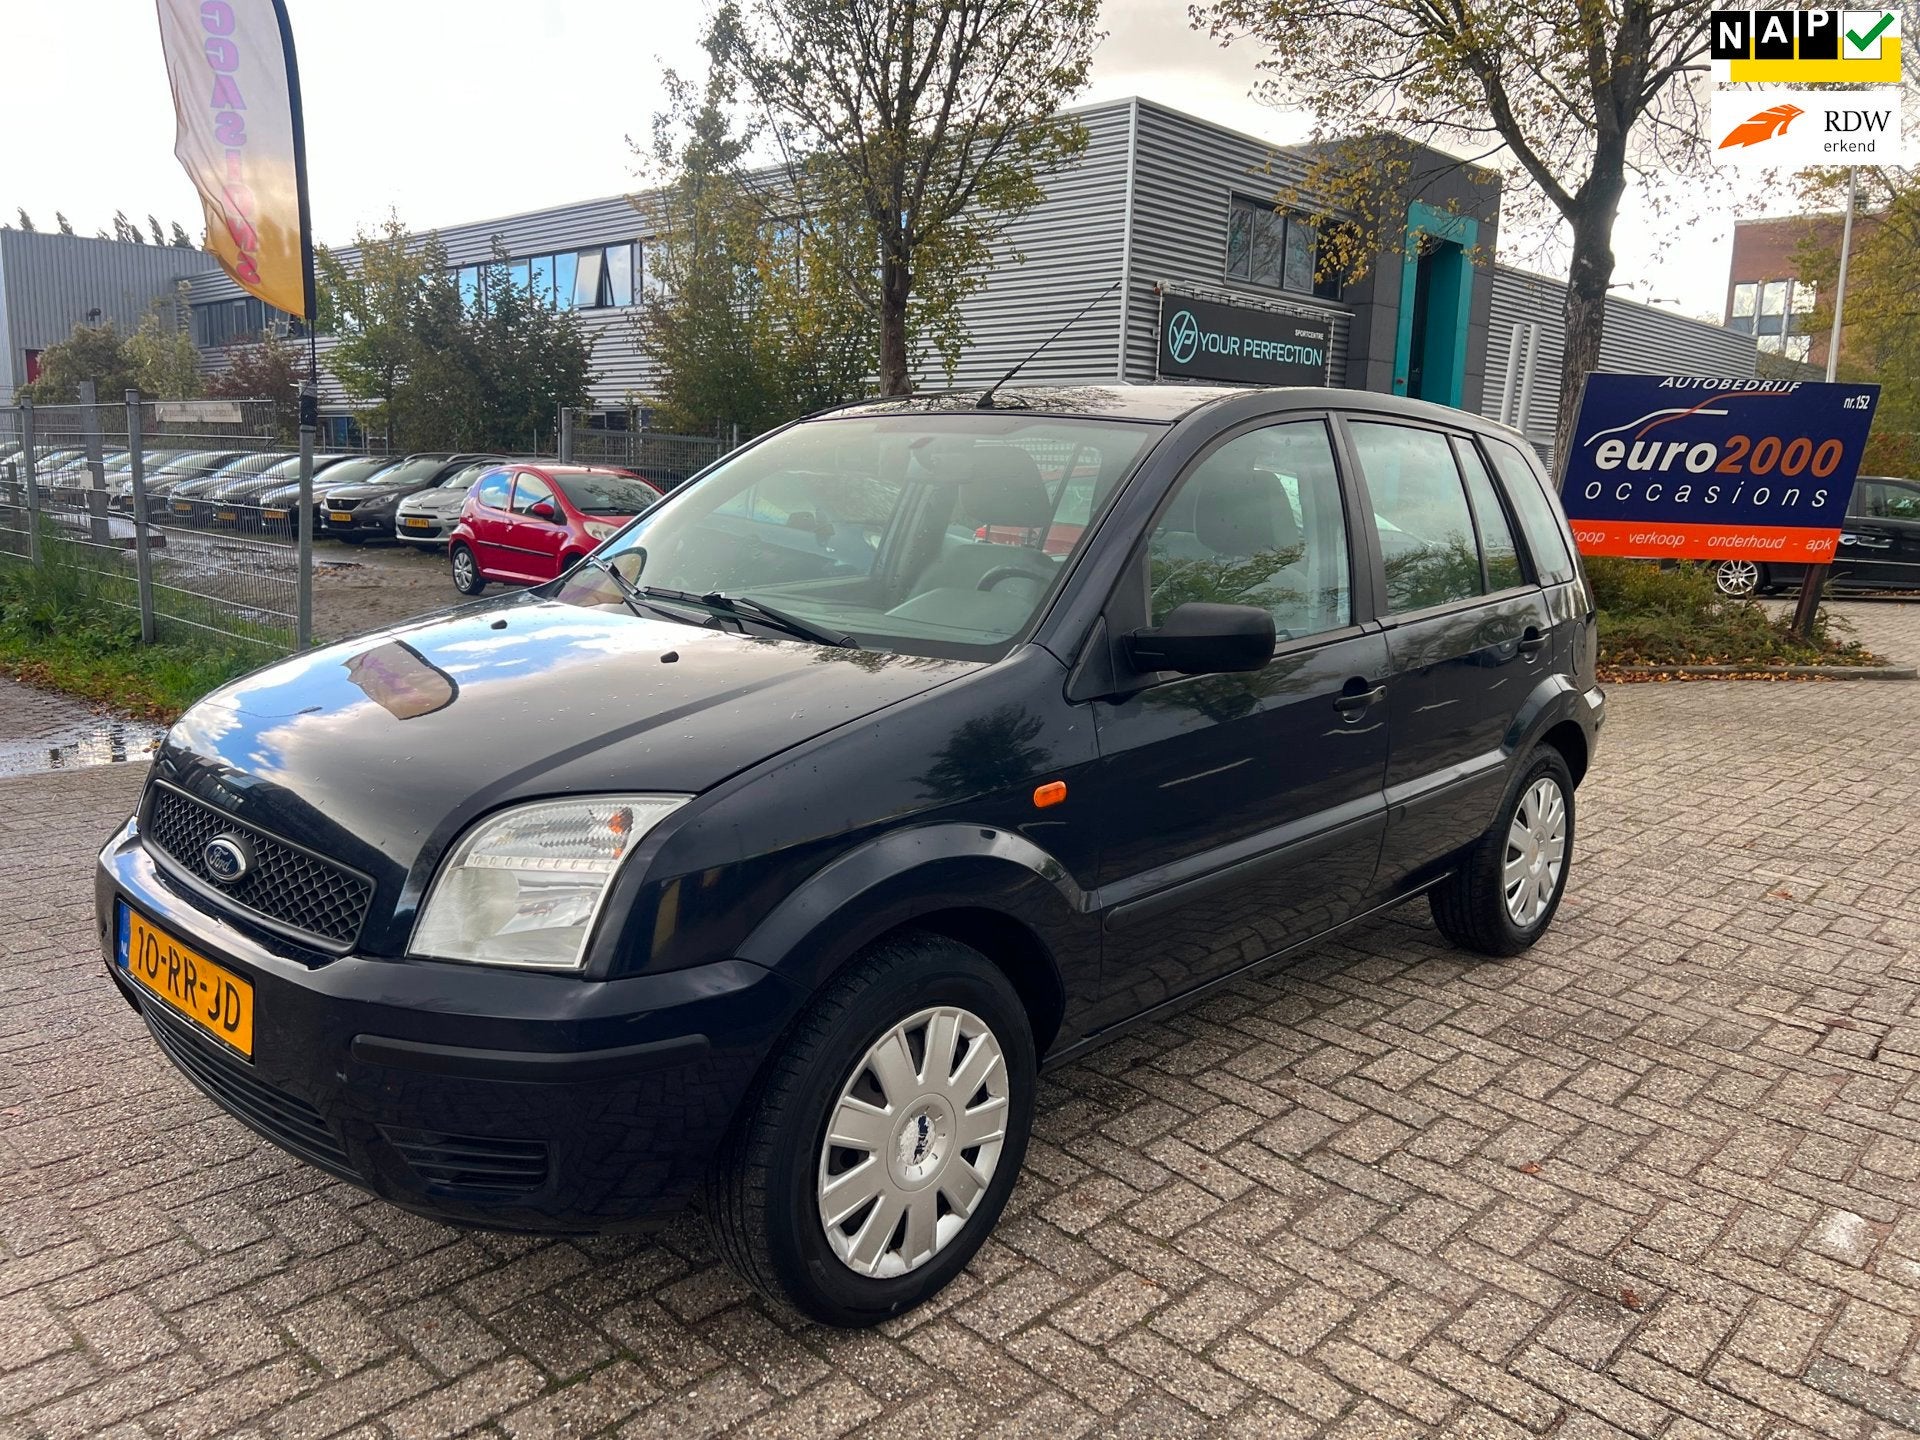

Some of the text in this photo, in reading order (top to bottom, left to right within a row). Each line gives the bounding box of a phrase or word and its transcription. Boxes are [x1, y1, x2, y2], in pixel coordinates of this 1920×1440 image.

[1294, 328, 1324, 341] SPORTCENTRE
[1199, 331, 1323, 367] YOUR PERFECTION
[1659, 376, 1802, 393] AUTOBEDRIJF
[1595, 434, 1844, 478] euro2000
[1584, 480, 1828, 508] occasions
[1628, 532, 1685, 548] verkoop
[1707, 535, 1786, 550] onderhoud
[1805, 537, 1832, 553] apk
[209, 846, 233, 872] Ford
[137, 925, 241, 1033] 10-RR-JD
